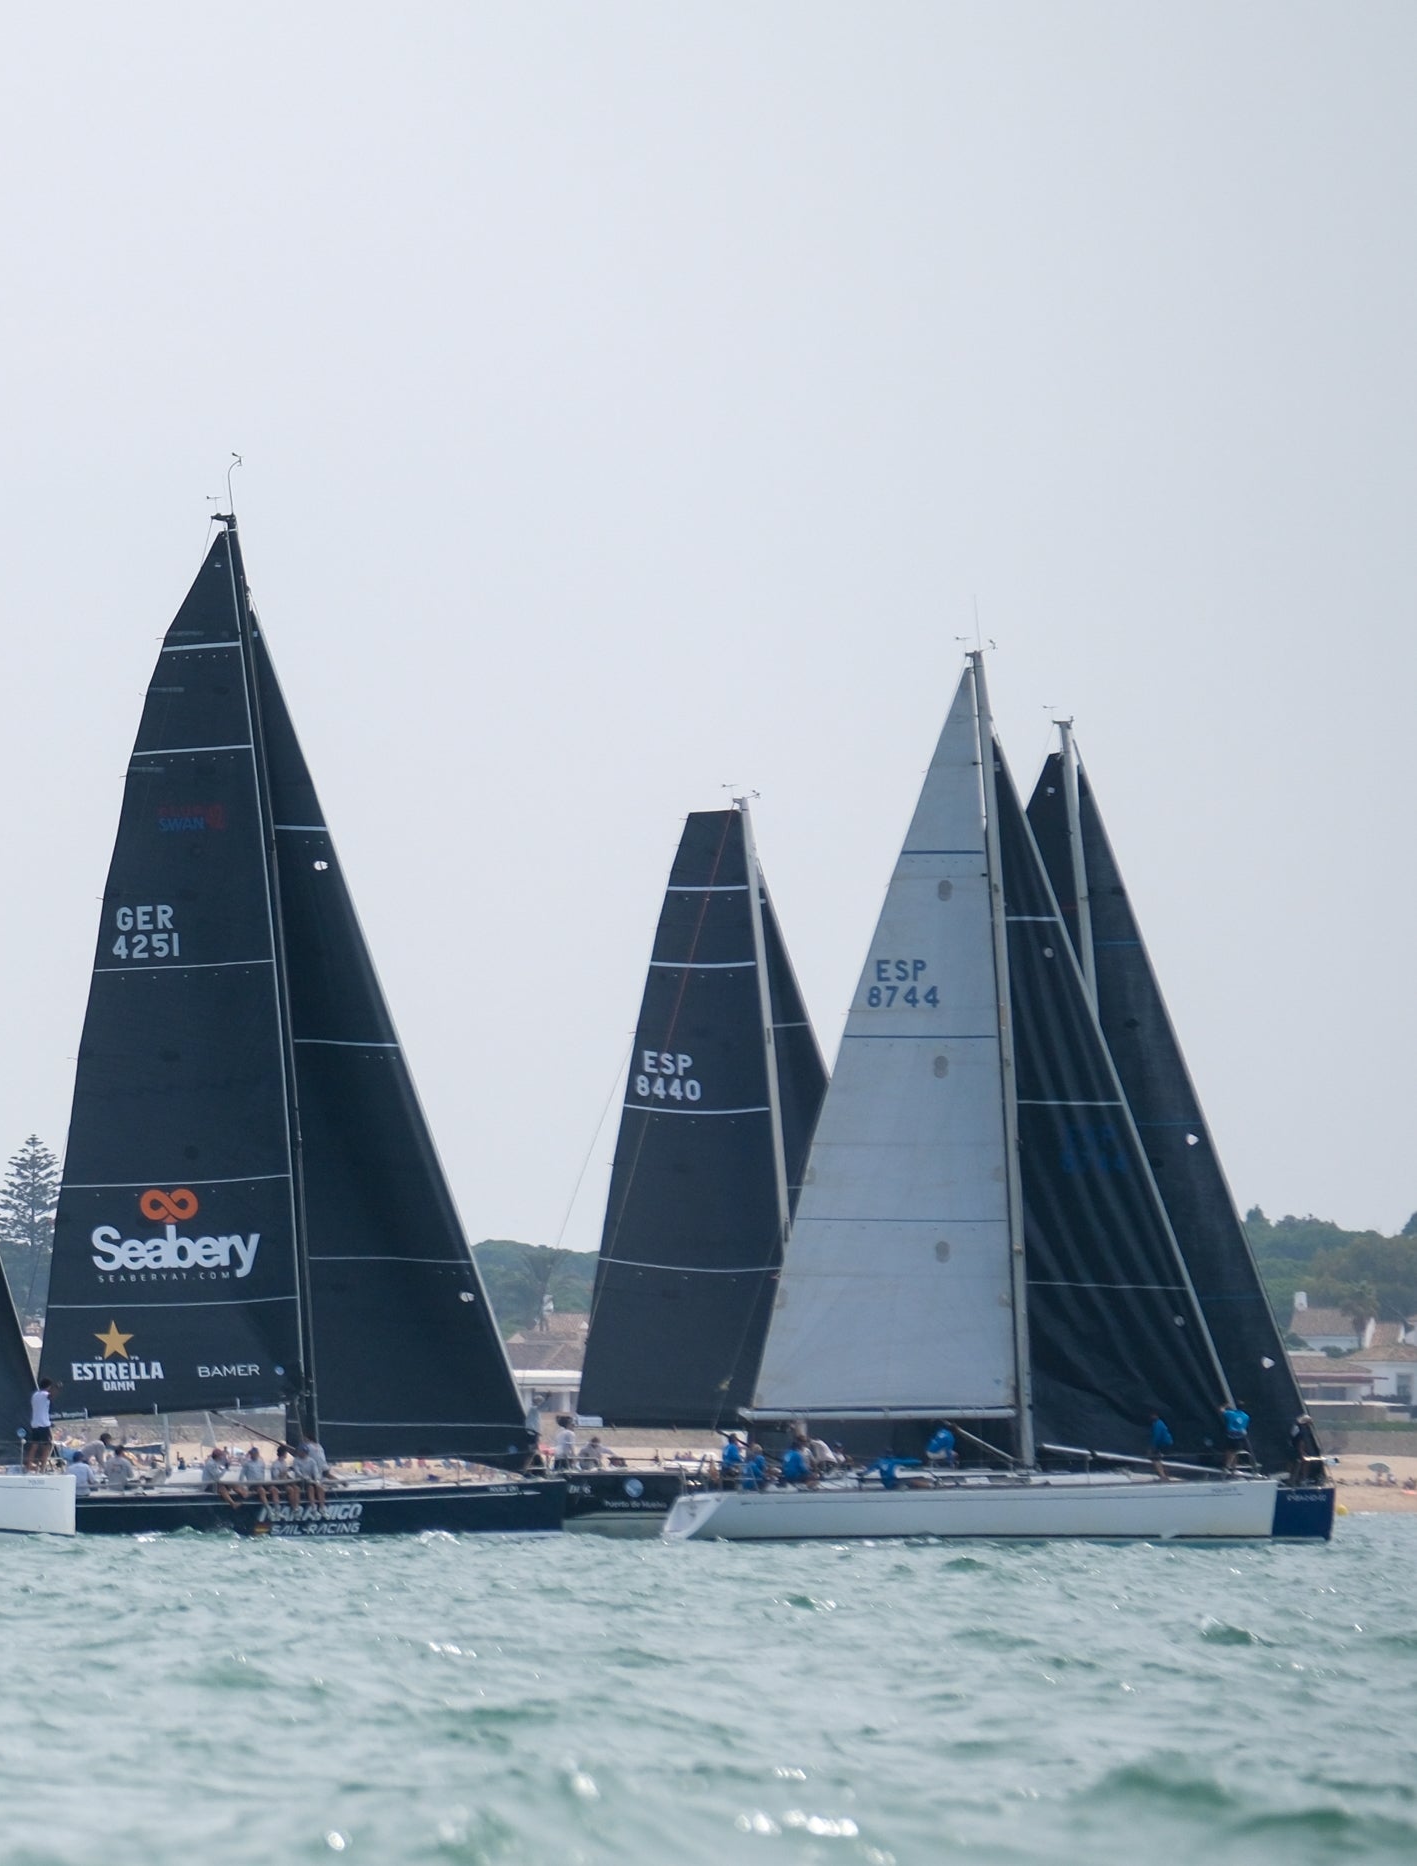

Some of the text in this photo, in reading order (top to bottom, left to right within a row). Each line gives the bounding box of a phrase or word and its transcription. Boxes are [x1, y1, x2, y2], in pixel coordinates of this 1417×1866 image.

[116, 904, 174, 932] GER
[112, 932, 180, 960] 4251
[876, 958, 927, 982] ESP
[867, 985, 940, 1009] 8744
[643, 1050, 693, 1076] ESP
[636, 1074, 701, 1102] 8440
[90, 1224, 261, 1279] Seabery
[71, 1361, 165, 1381] ESTRELLA
[197, 1363, 261, 1378] BAMER
[103, 1380, 136, 1392] DAMM
[270, 1522, 361, 1535] SAIL-RACING
